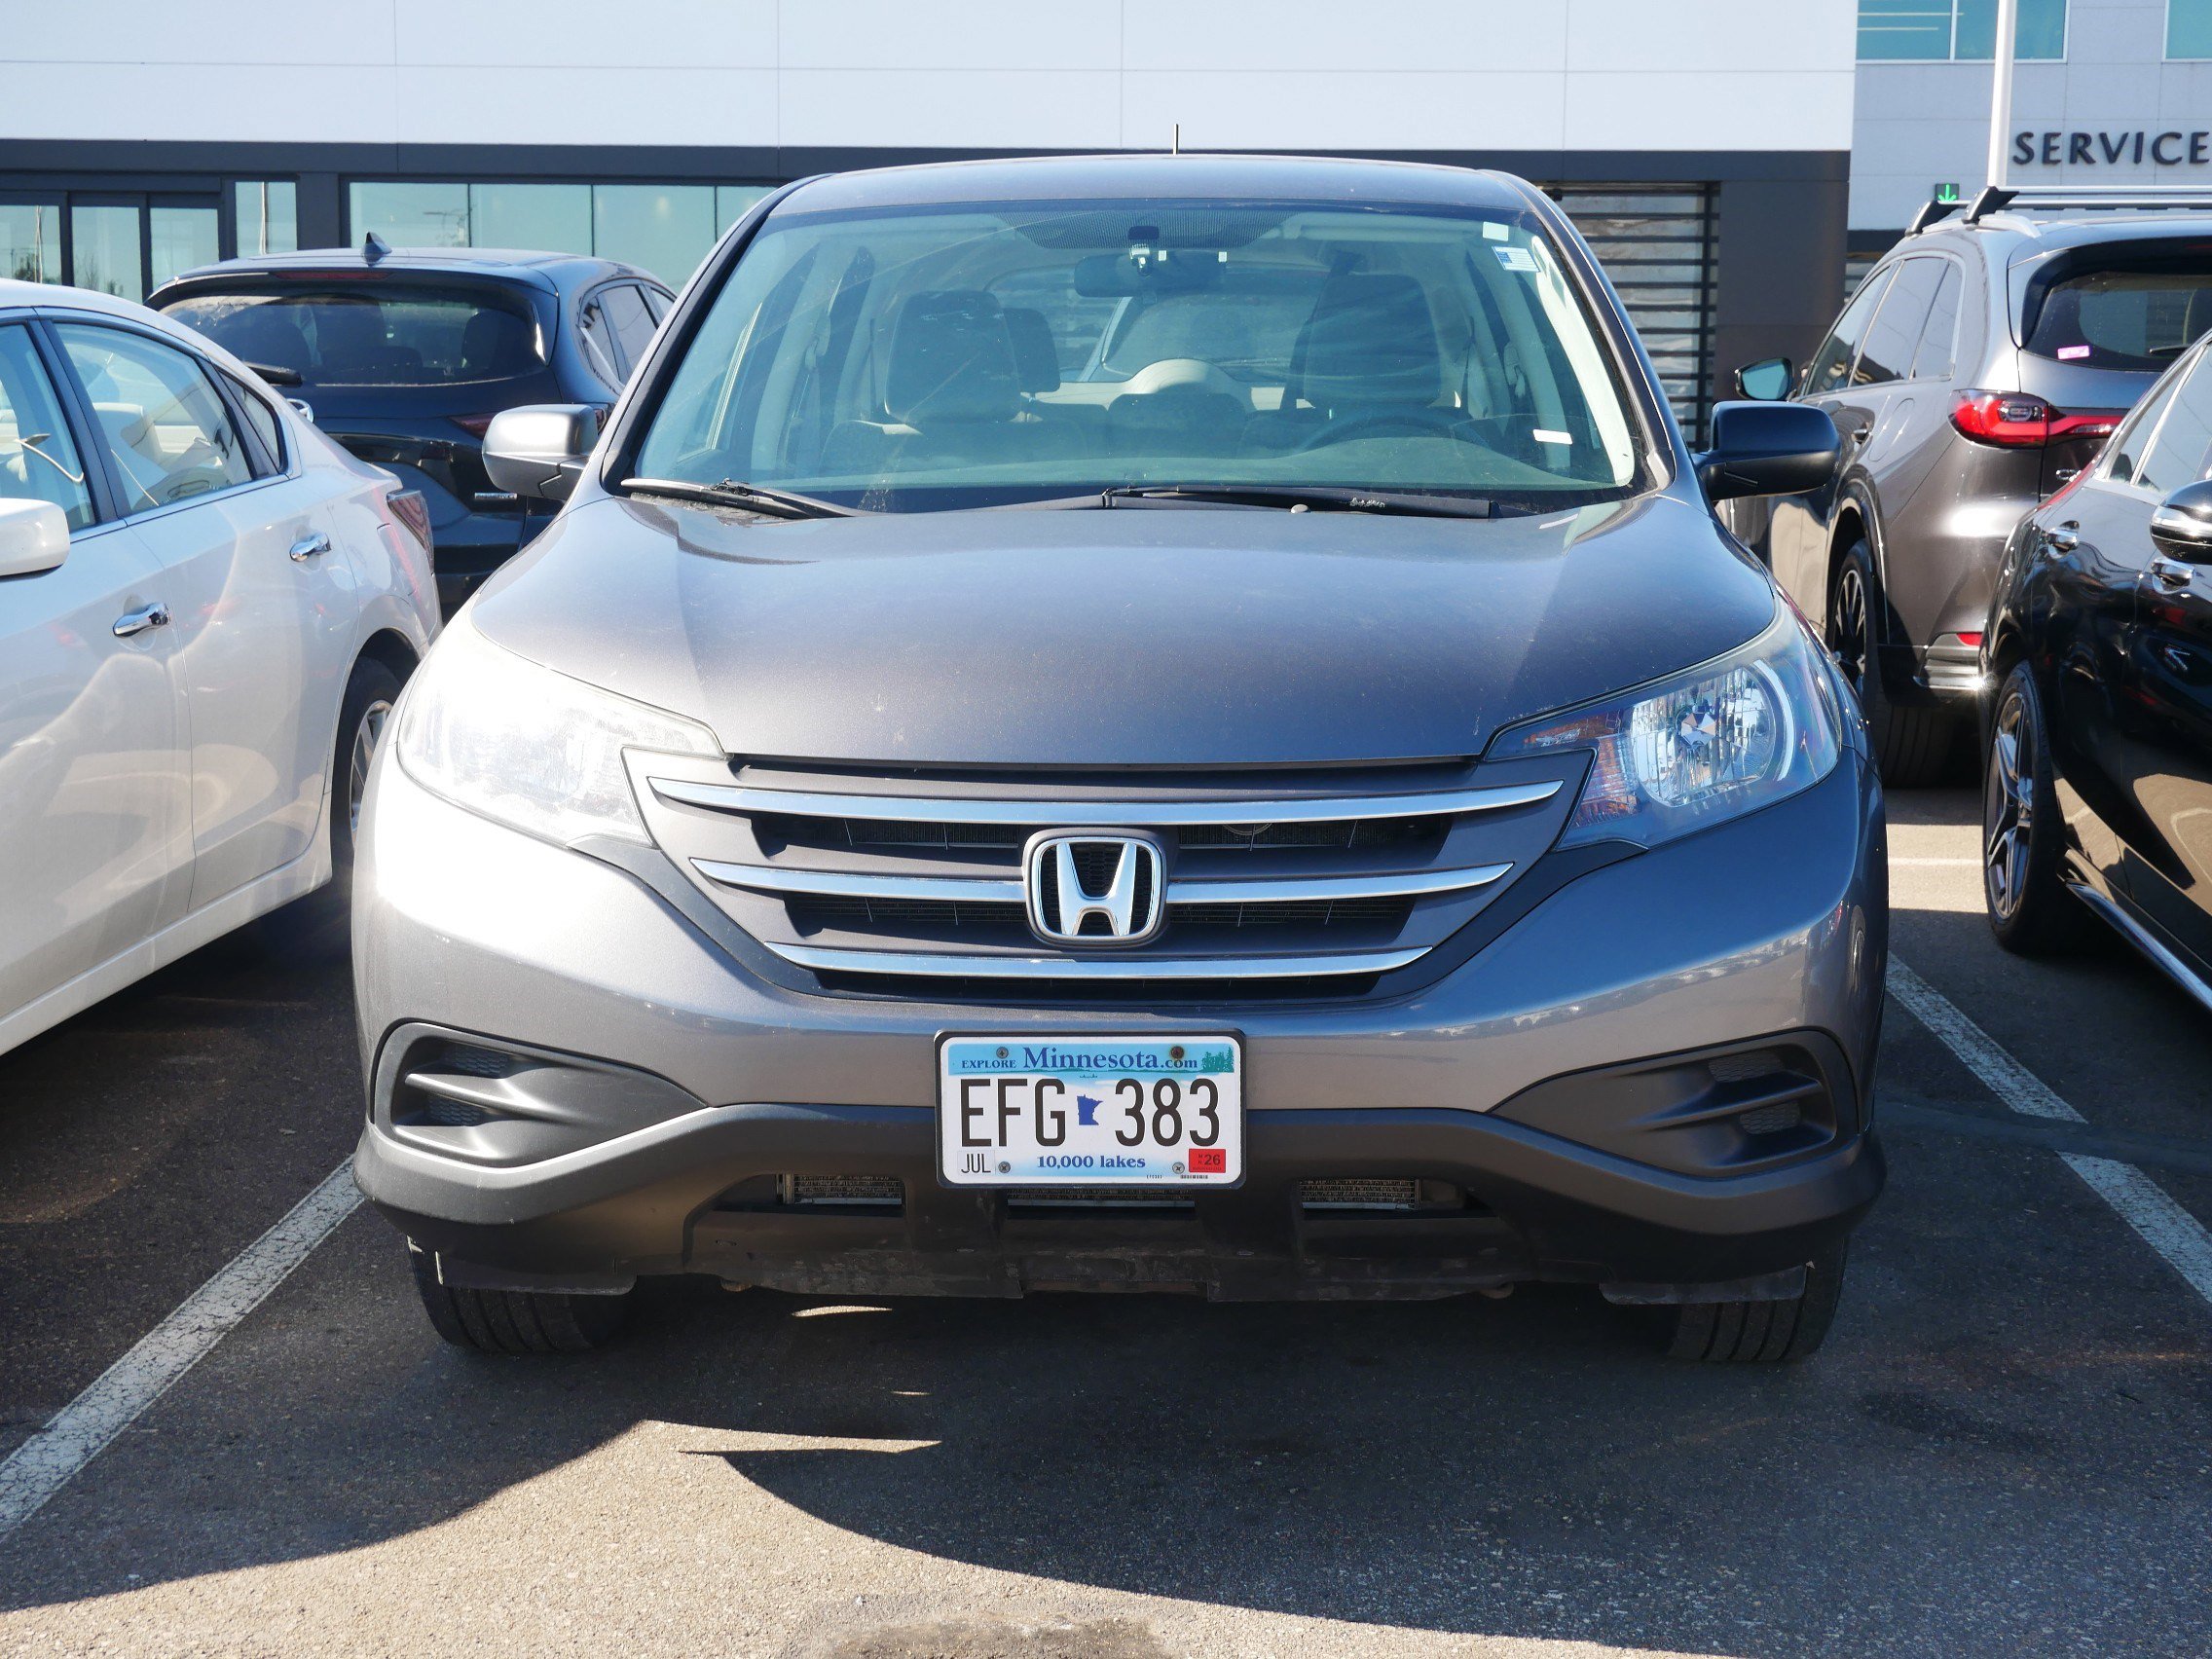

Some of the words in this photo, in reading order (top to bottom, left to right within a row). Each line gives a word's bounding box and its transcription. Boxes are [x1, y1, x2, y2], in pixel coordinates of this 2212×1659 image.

[2011, 130, 2211, 166] SERVICE
[961, 1059, 1017, 1069] EXPLORE
[1022, 1047, 1198, 1070] Minnesota.com
[960, 1078, 1066, 1147] EFG
[1115, 1078, 1220, 1147] 383
[960, 1153, 992, 1174] JUL
[1036, 1155, 1093, 1169] 10,000
[1099, 1155, 1146, 1168] lakes
[1204, 1154, 1221, 1166] 26
